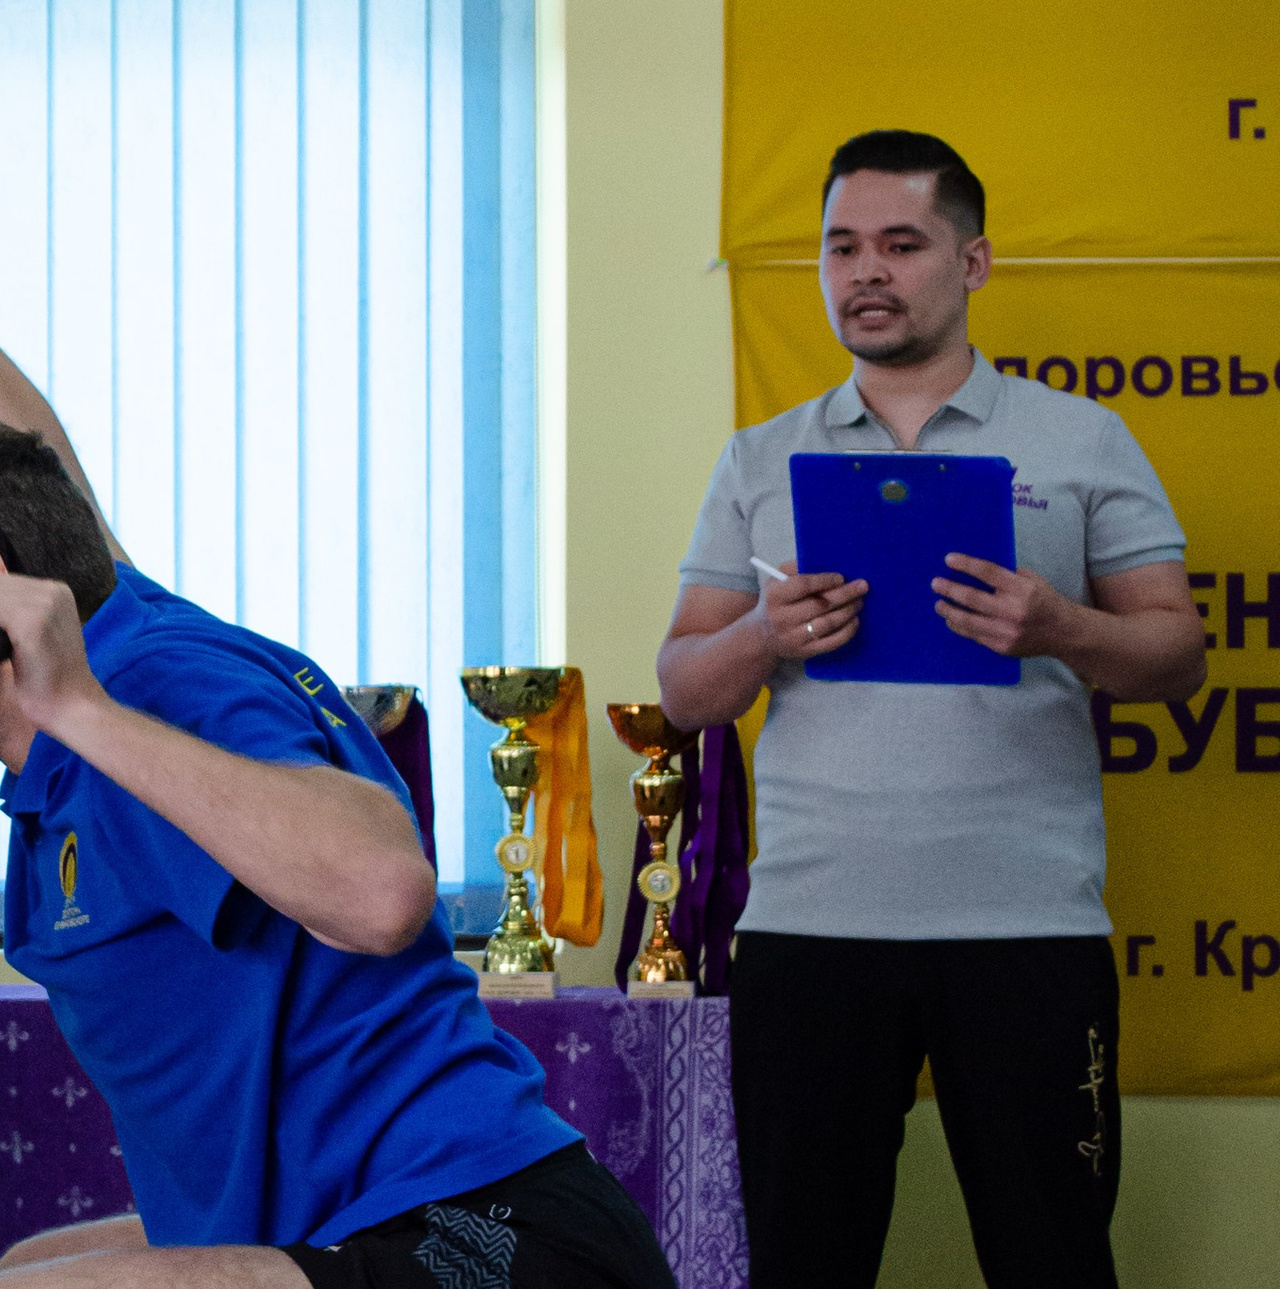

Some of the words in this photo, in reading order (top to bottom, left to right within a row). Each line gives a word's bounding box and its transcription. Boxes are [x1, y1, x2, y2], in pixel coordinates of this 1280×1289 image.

[993, 355, 1280, 401] оровь
[1126, 935, 1164, 977] г.
[1194, 920, 1280, 992] Кр
